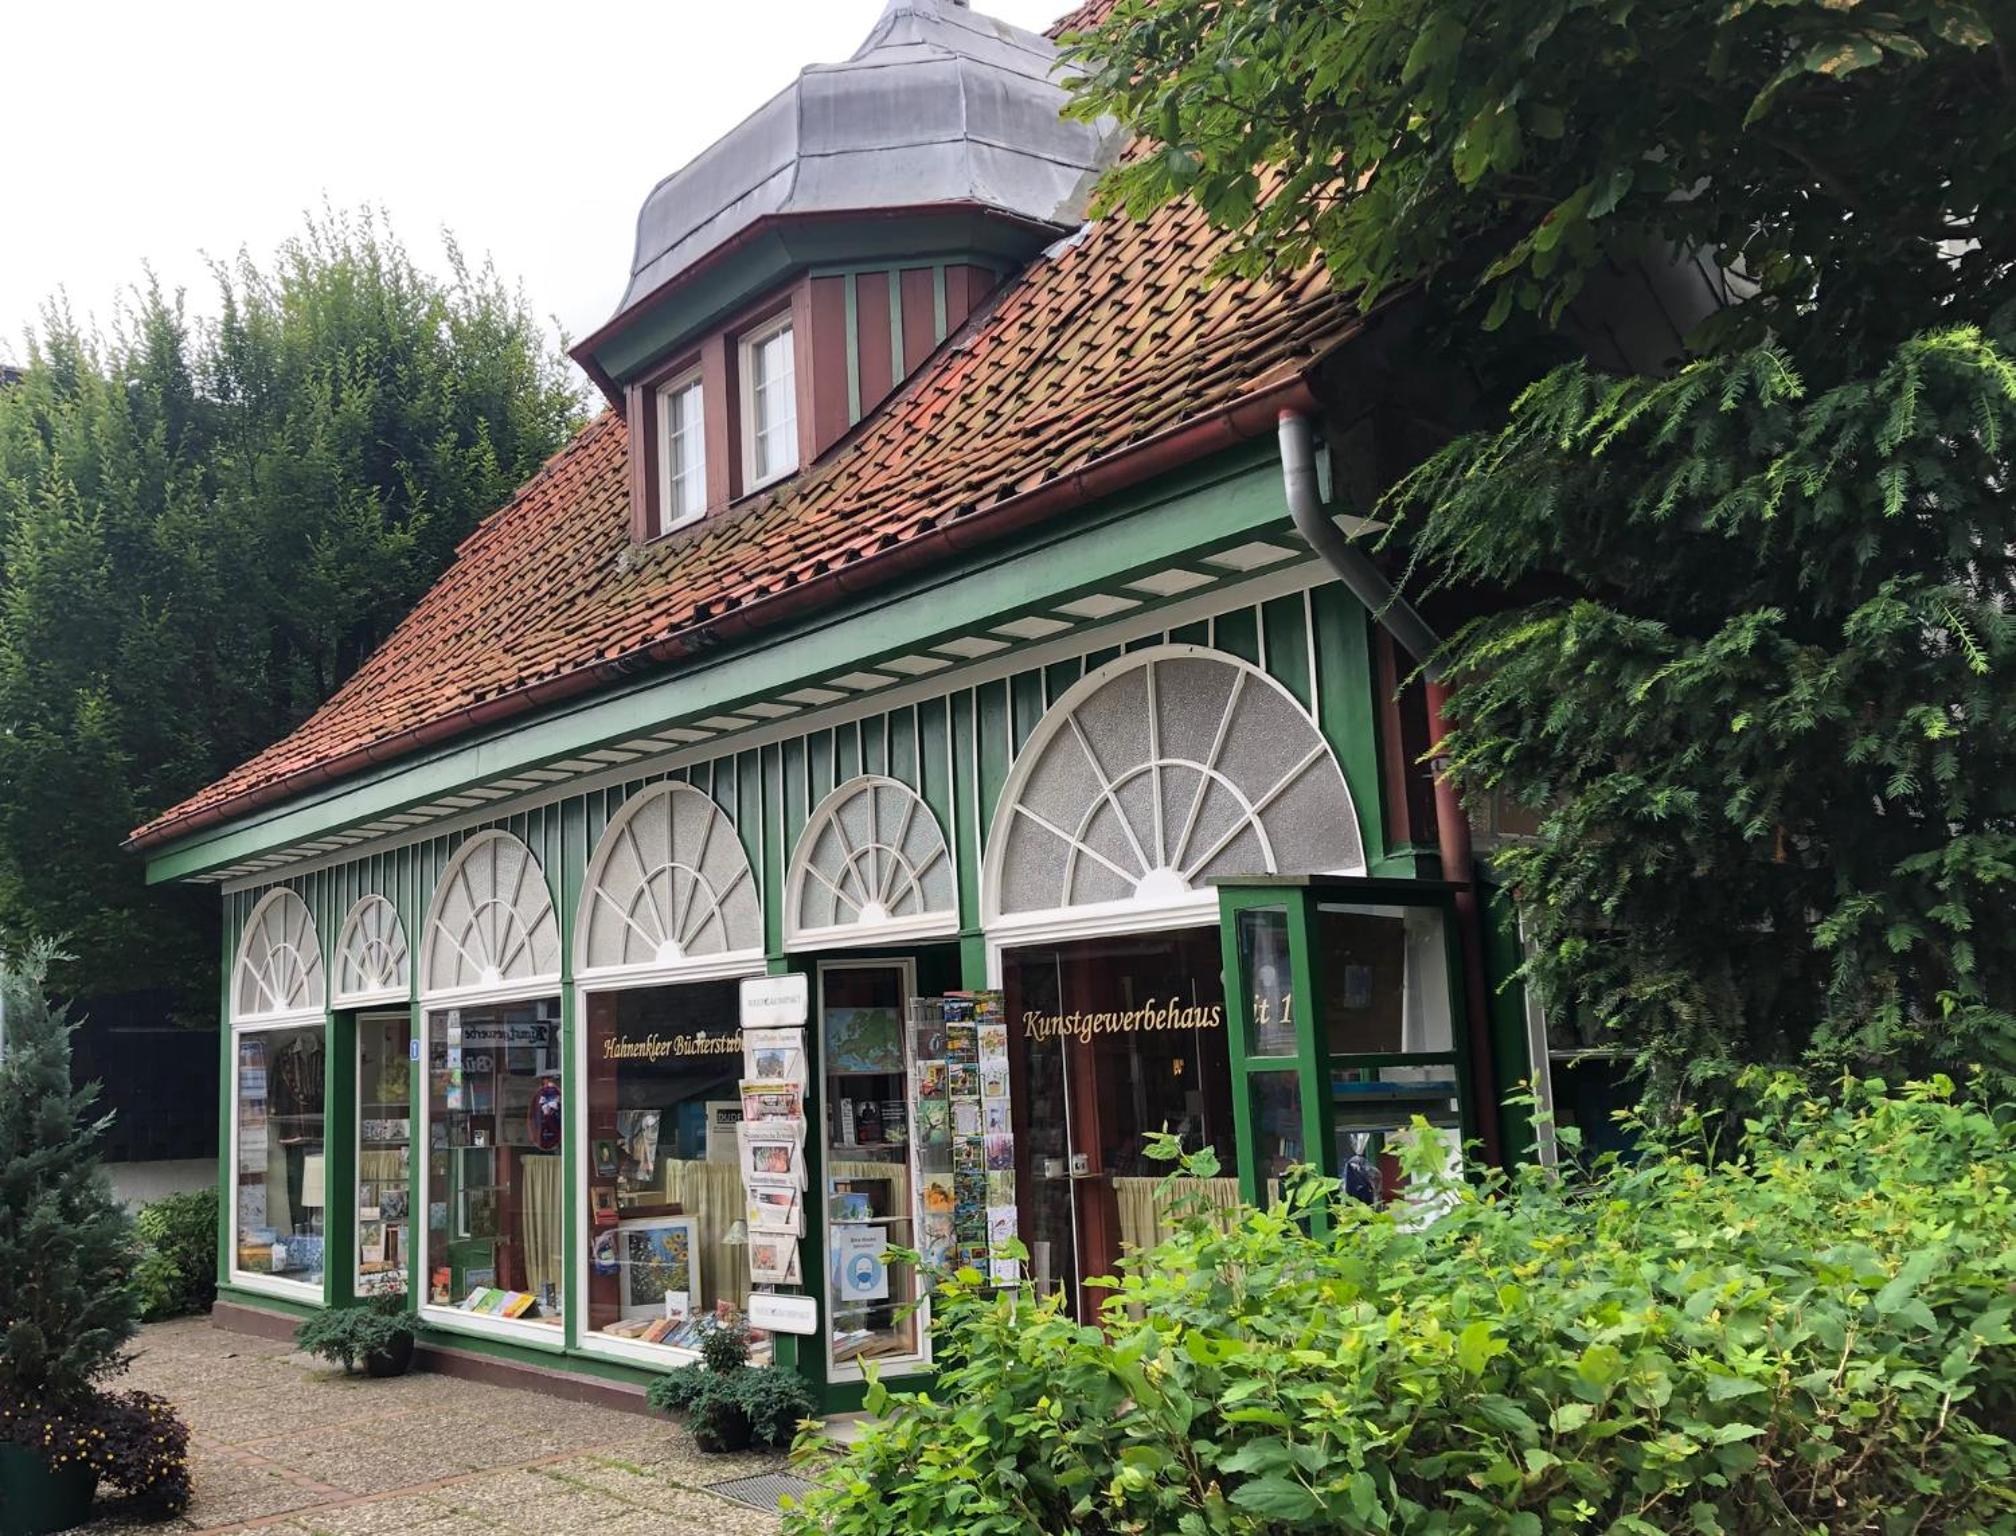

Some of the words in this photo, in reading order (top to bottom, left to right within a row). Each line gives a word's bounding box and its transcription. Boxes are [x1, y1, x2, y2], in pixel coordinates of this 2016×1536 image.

[1023, 996, 1222, 1044] Kunstgewerbehaus
[1253, 994, 1270, 1024] it
[1279, 993, 1292, 1024] 1
[603, 1033, 673, 1063] Hahnenkleer
